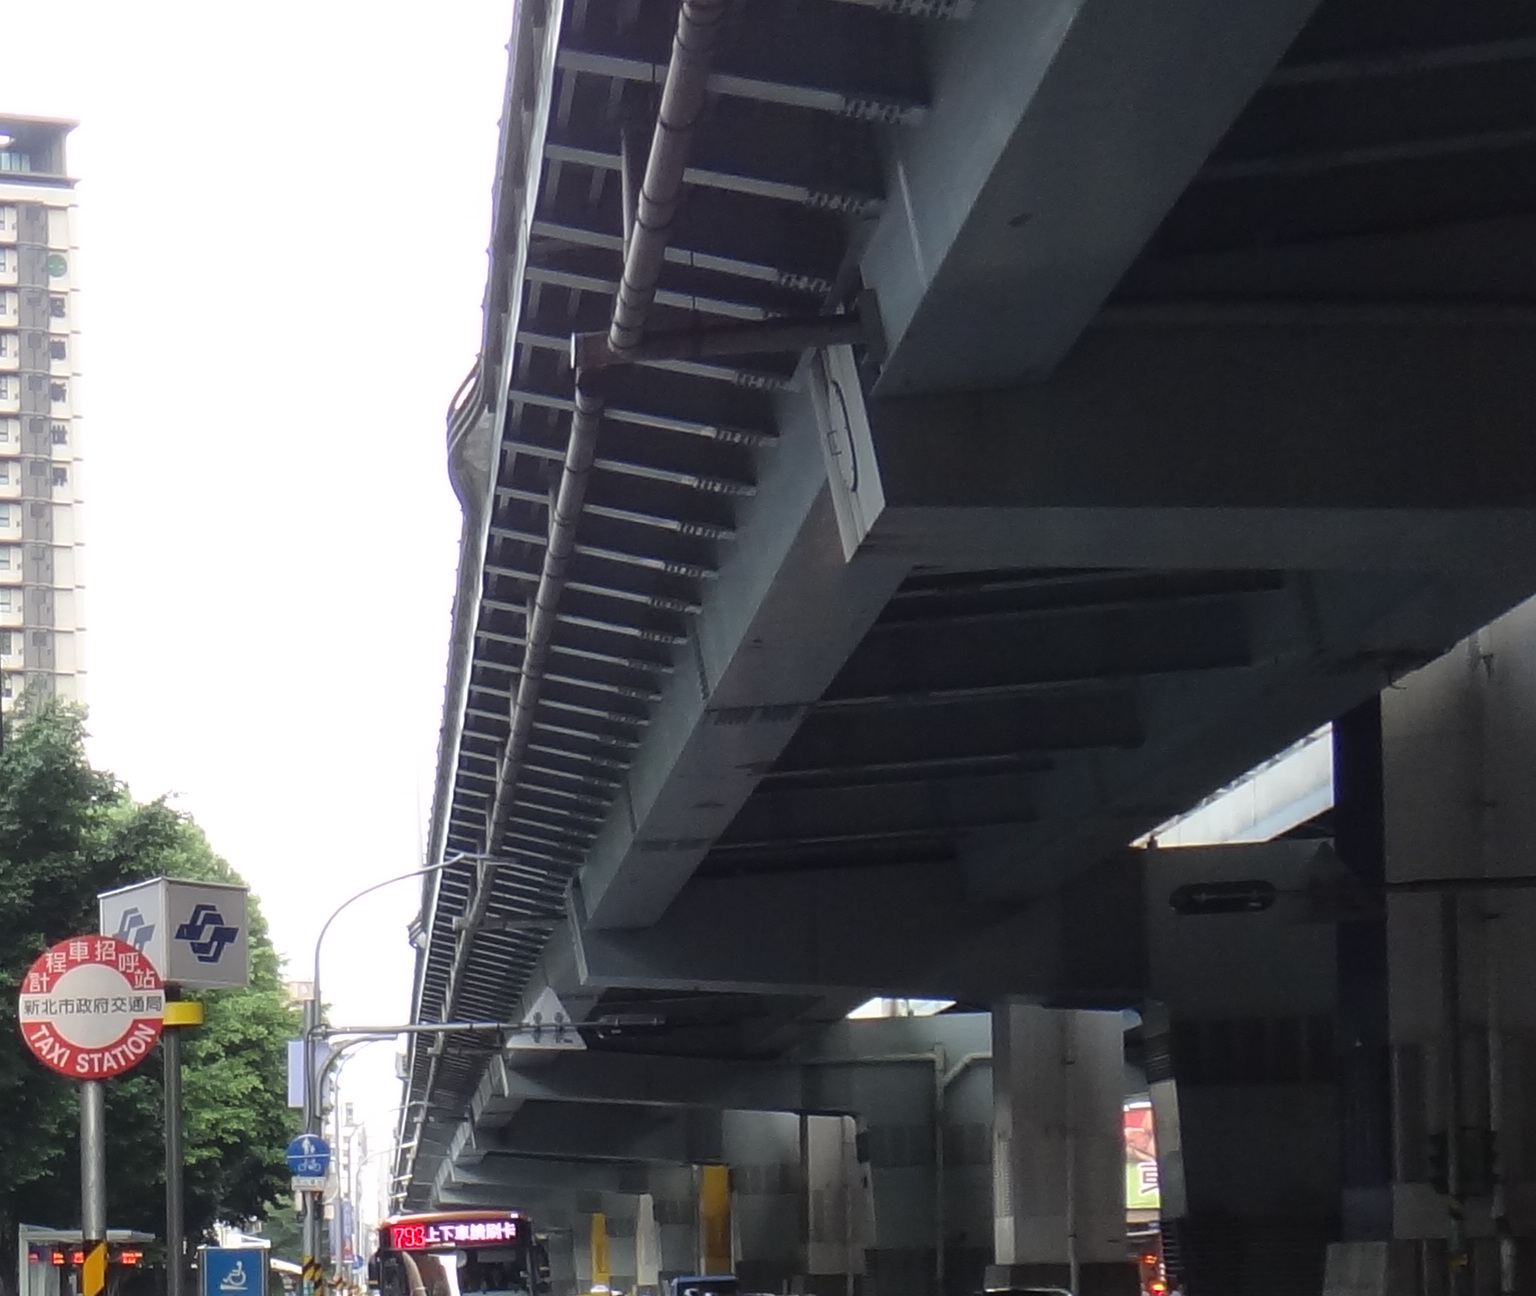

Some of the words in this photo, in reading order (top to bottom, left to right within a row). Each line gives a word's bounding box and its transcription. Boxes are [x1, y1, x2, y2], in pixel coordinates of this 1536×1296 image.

[29, 940, 156, 993] 計程車招呼站
[24, 996, 163, 1016] 新北市政府交通局
[29, 1025, 71, 1068] TAXI
[76, 1023, 156, 1074] STATION
[393, 1226, 425, 1248] 793
